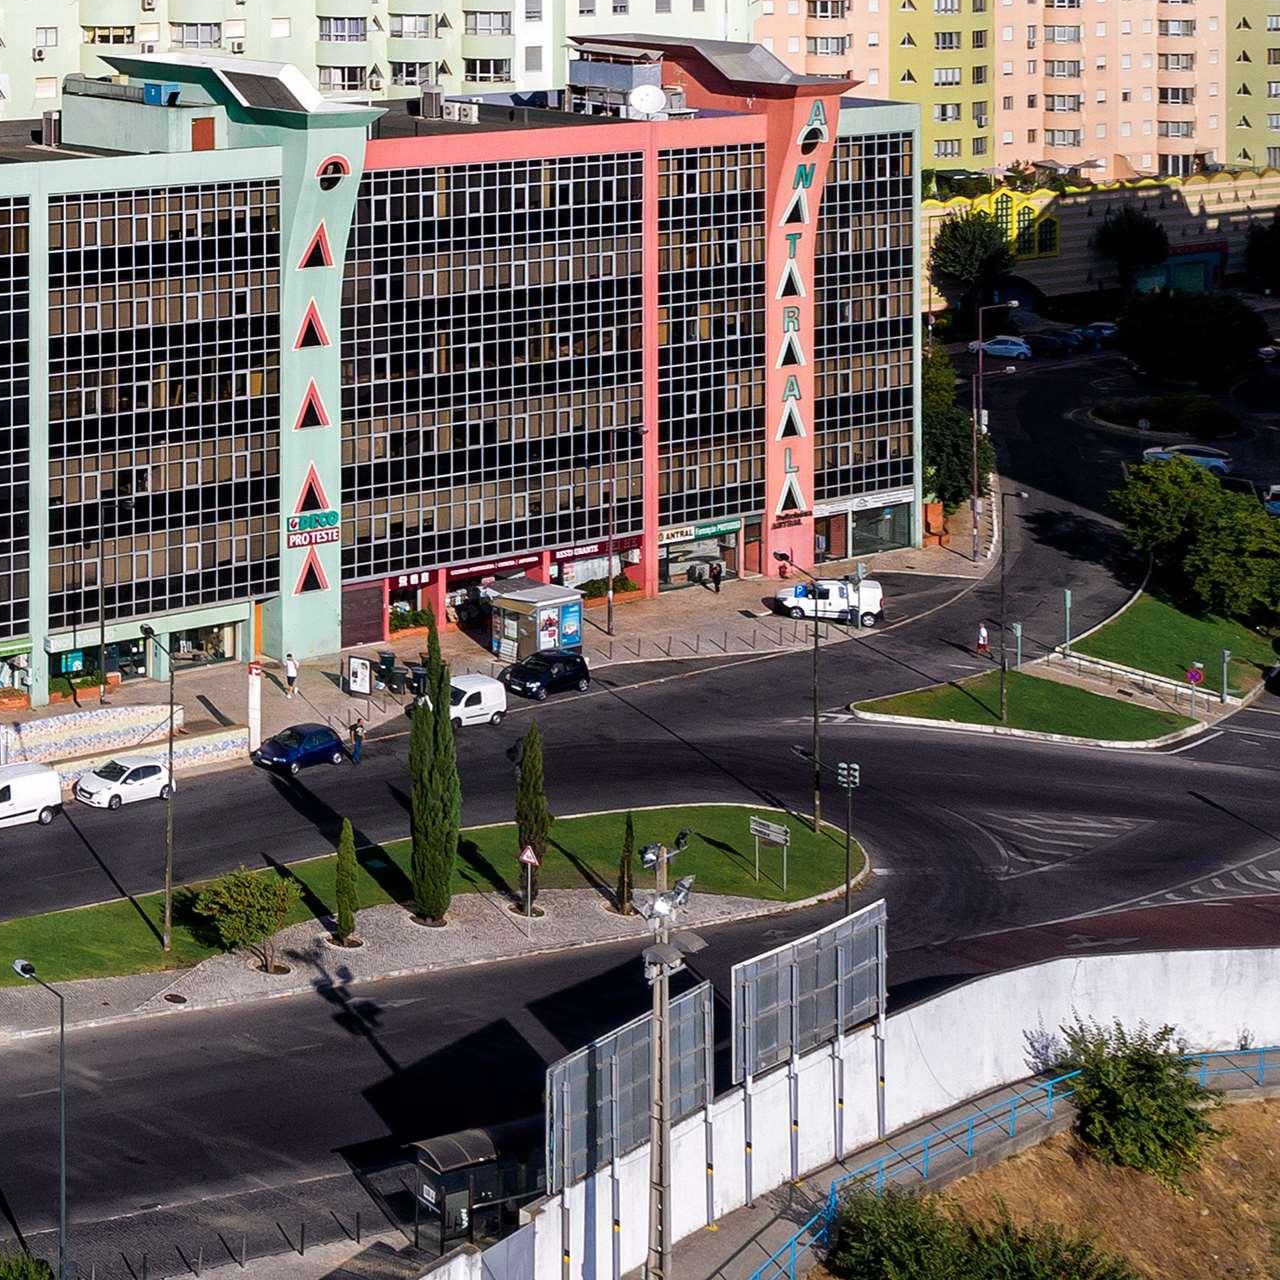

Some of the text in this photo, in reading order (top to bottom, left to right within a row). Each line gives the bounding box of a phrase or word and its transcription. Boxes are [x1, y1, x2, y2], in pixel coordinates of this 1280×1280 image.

[289, 529, 339, 547] PRO TESTE
[665, 528, 694, 540] ANTRAL
